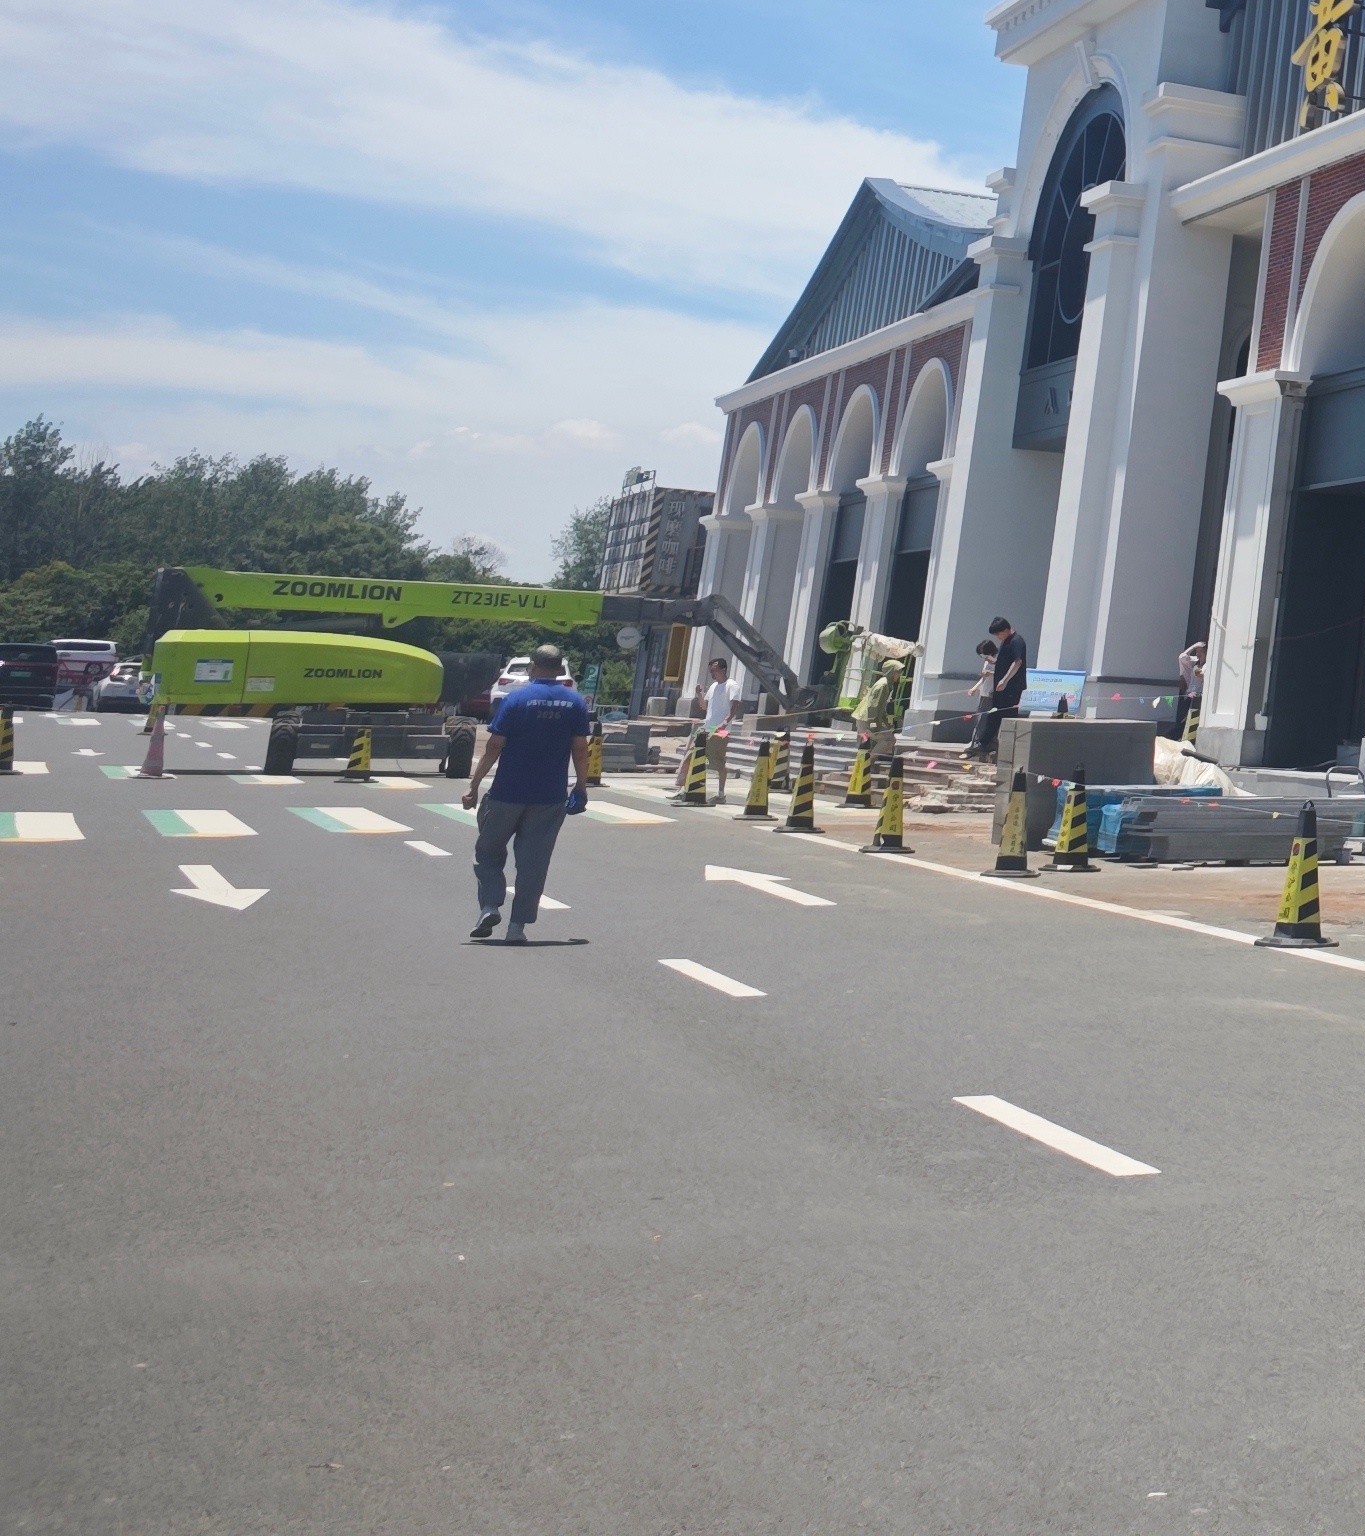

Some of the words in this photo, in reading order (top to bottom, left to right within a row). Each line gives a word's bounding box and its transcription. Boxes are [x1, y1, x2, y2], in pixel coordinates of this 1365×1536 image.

[658, 500, 686, 575] 现磨咖啡
[272, 580, 402, 601] ZOOMLION
[451, 590, 529, 608] ZT23JE-V
[303, 667, 383, 678] ZOOMLION
